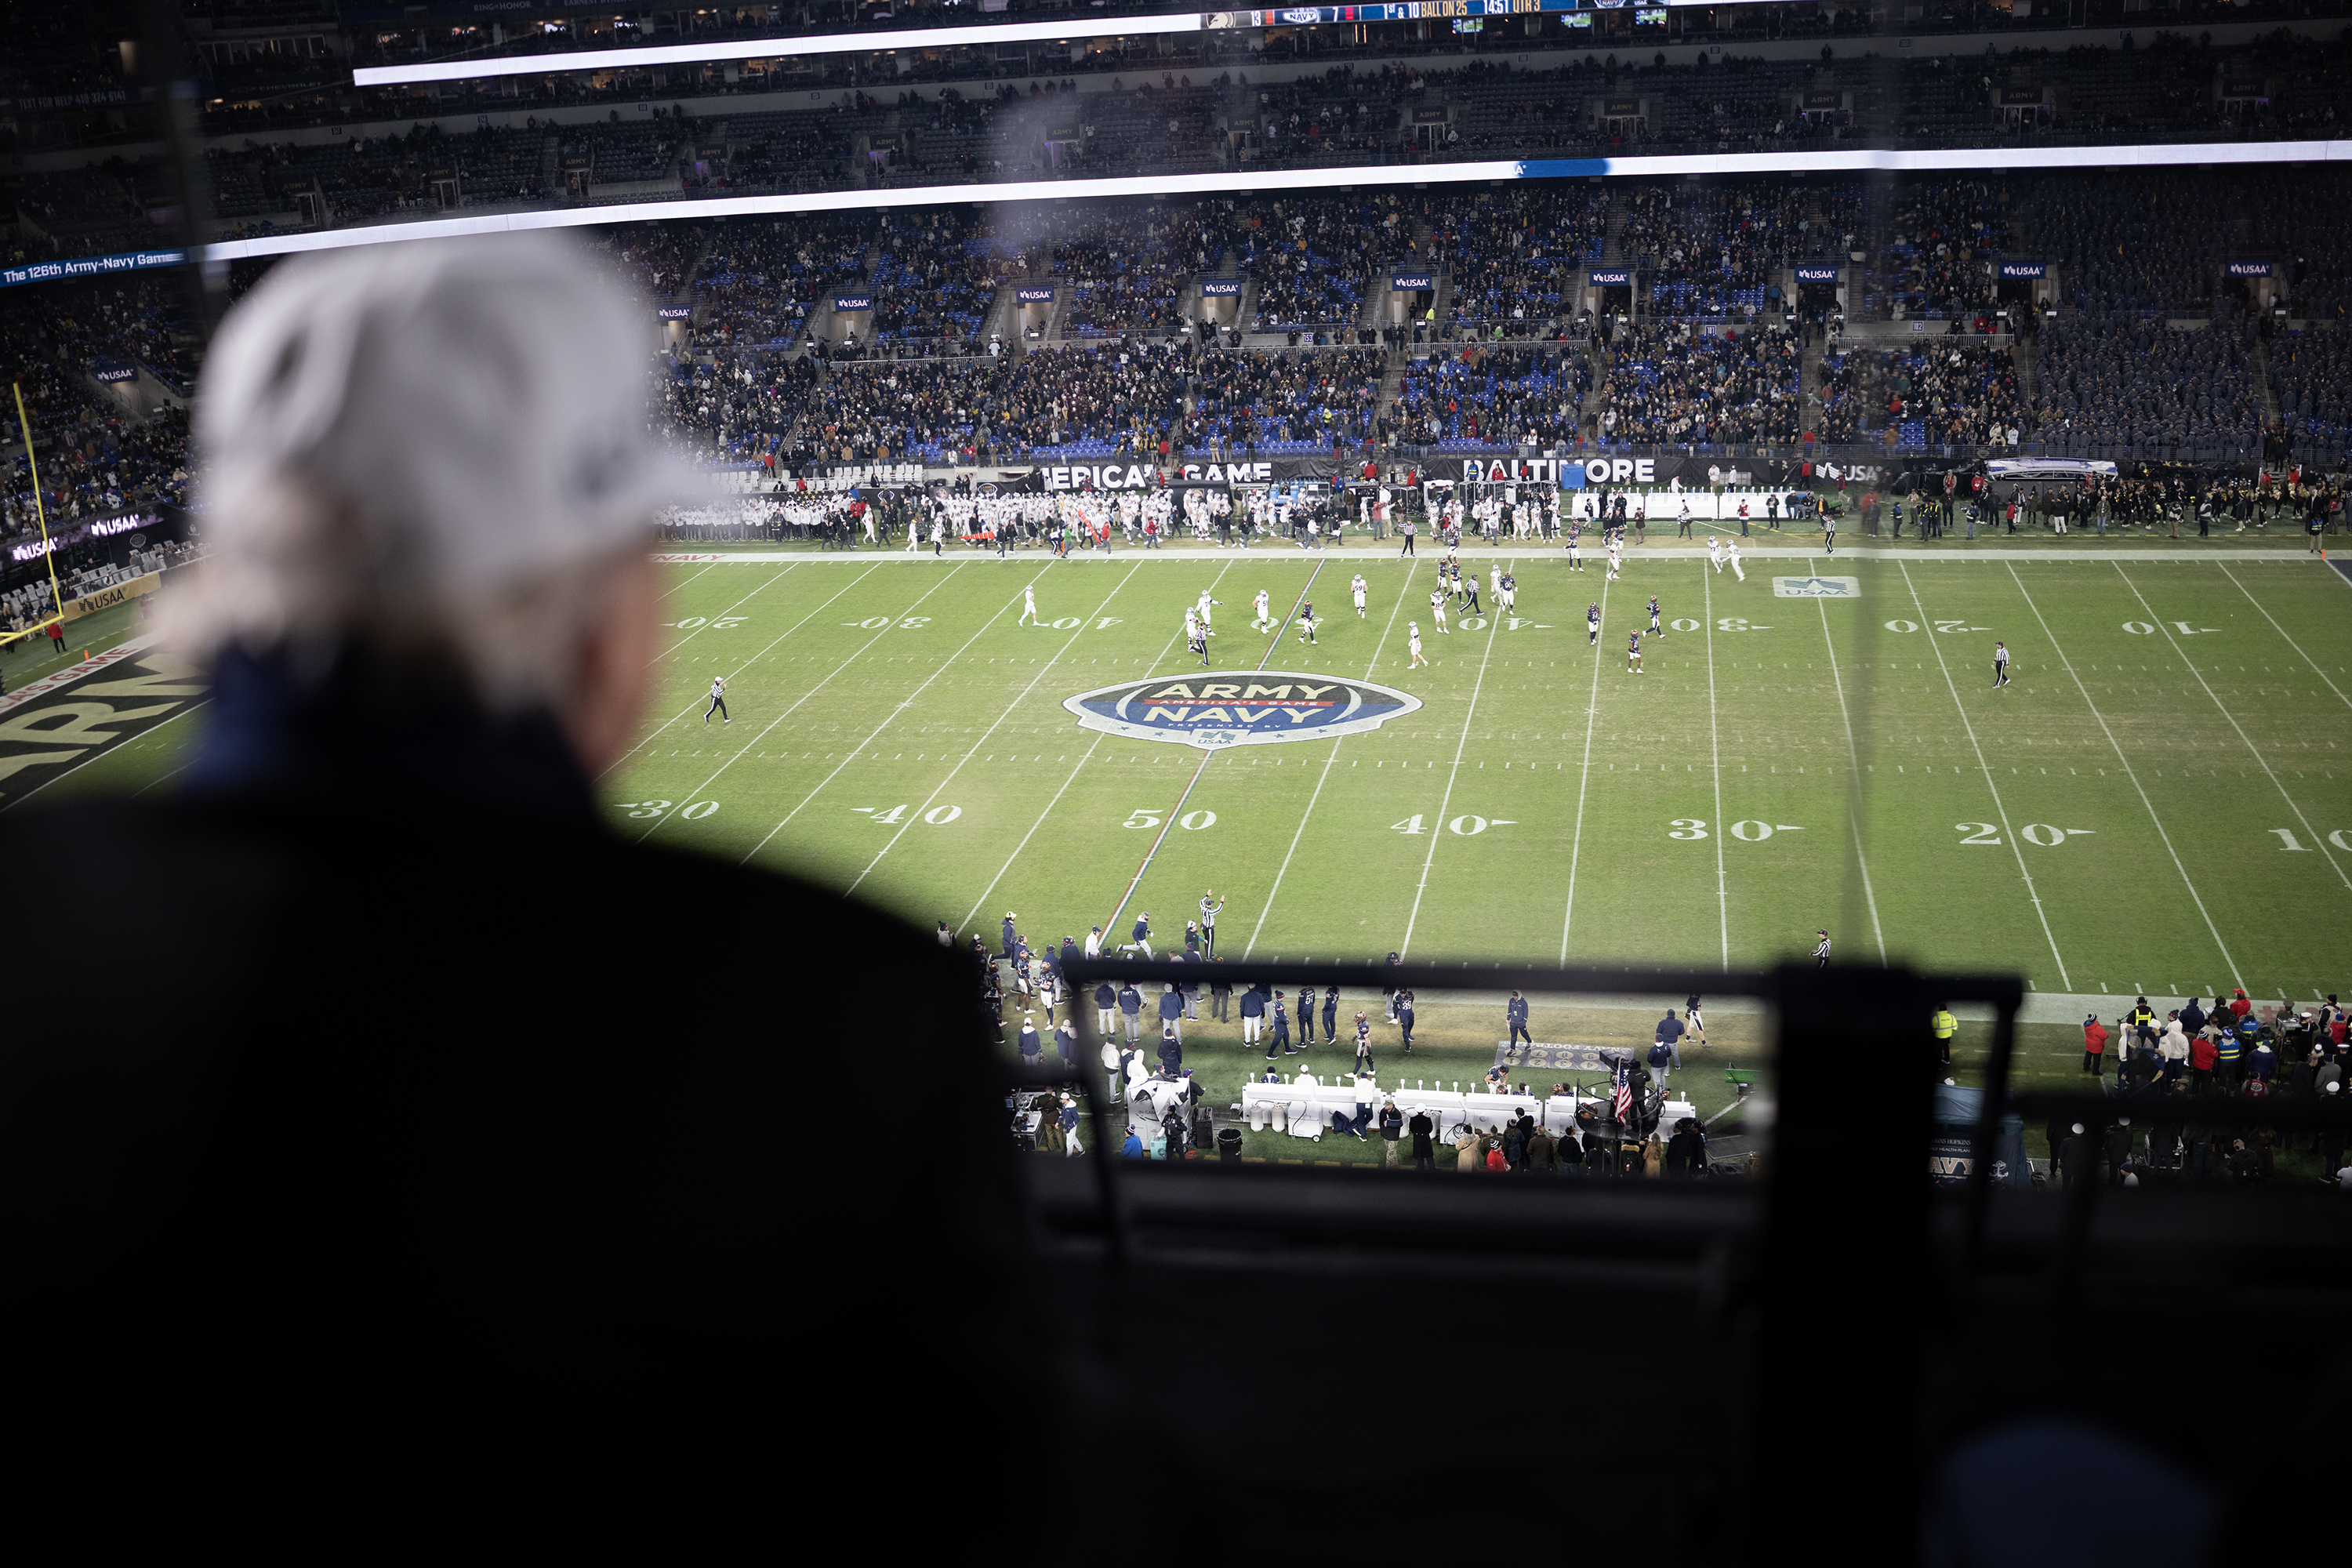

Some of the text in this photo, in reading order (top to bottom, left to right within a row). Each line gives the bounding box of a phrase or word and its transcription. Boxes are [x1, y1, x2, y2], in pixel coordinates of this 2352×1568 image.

[499, 1, 532, 10] HONOR
[1333, 6, 1339, 23] 7
[1398, 7, 1404, 19] &
[1409, 2, 1419, 18] 10
[1421, 0, 1468, 17] BALL ON 25
[1483, 0, 1508, 14] 14:51
[1250, 9, 1261, 27] 13
[1290, 12, 1315, 21] NAVY
[18, 97, 38, 109] TEXT
[38, 96, 54, 108] FOR
[55, 95, 74, 107] HELP
[3, 270, 27, 283] The
[27, 263, 62, 279] 126th
[65, 256, 135, 274] Army-Navy
[95, 589, 125, 608] USAA
[49, 648, 140, 683] GAME
[1150, 684, 1338, 700] ARMY
[1143, 706, 1326, 724] NAVY
[628, 800, 720, 820] 30
[869, 804, 962, 825] 40
[1123, 808, 1218, 830] 50
[1389, 814, 1487, 836] 40
[1668, 818, 1773, 841] 30
[1955, 822, 2066, 847] 20
[1927, 1156, 1975, 1175] AVY
